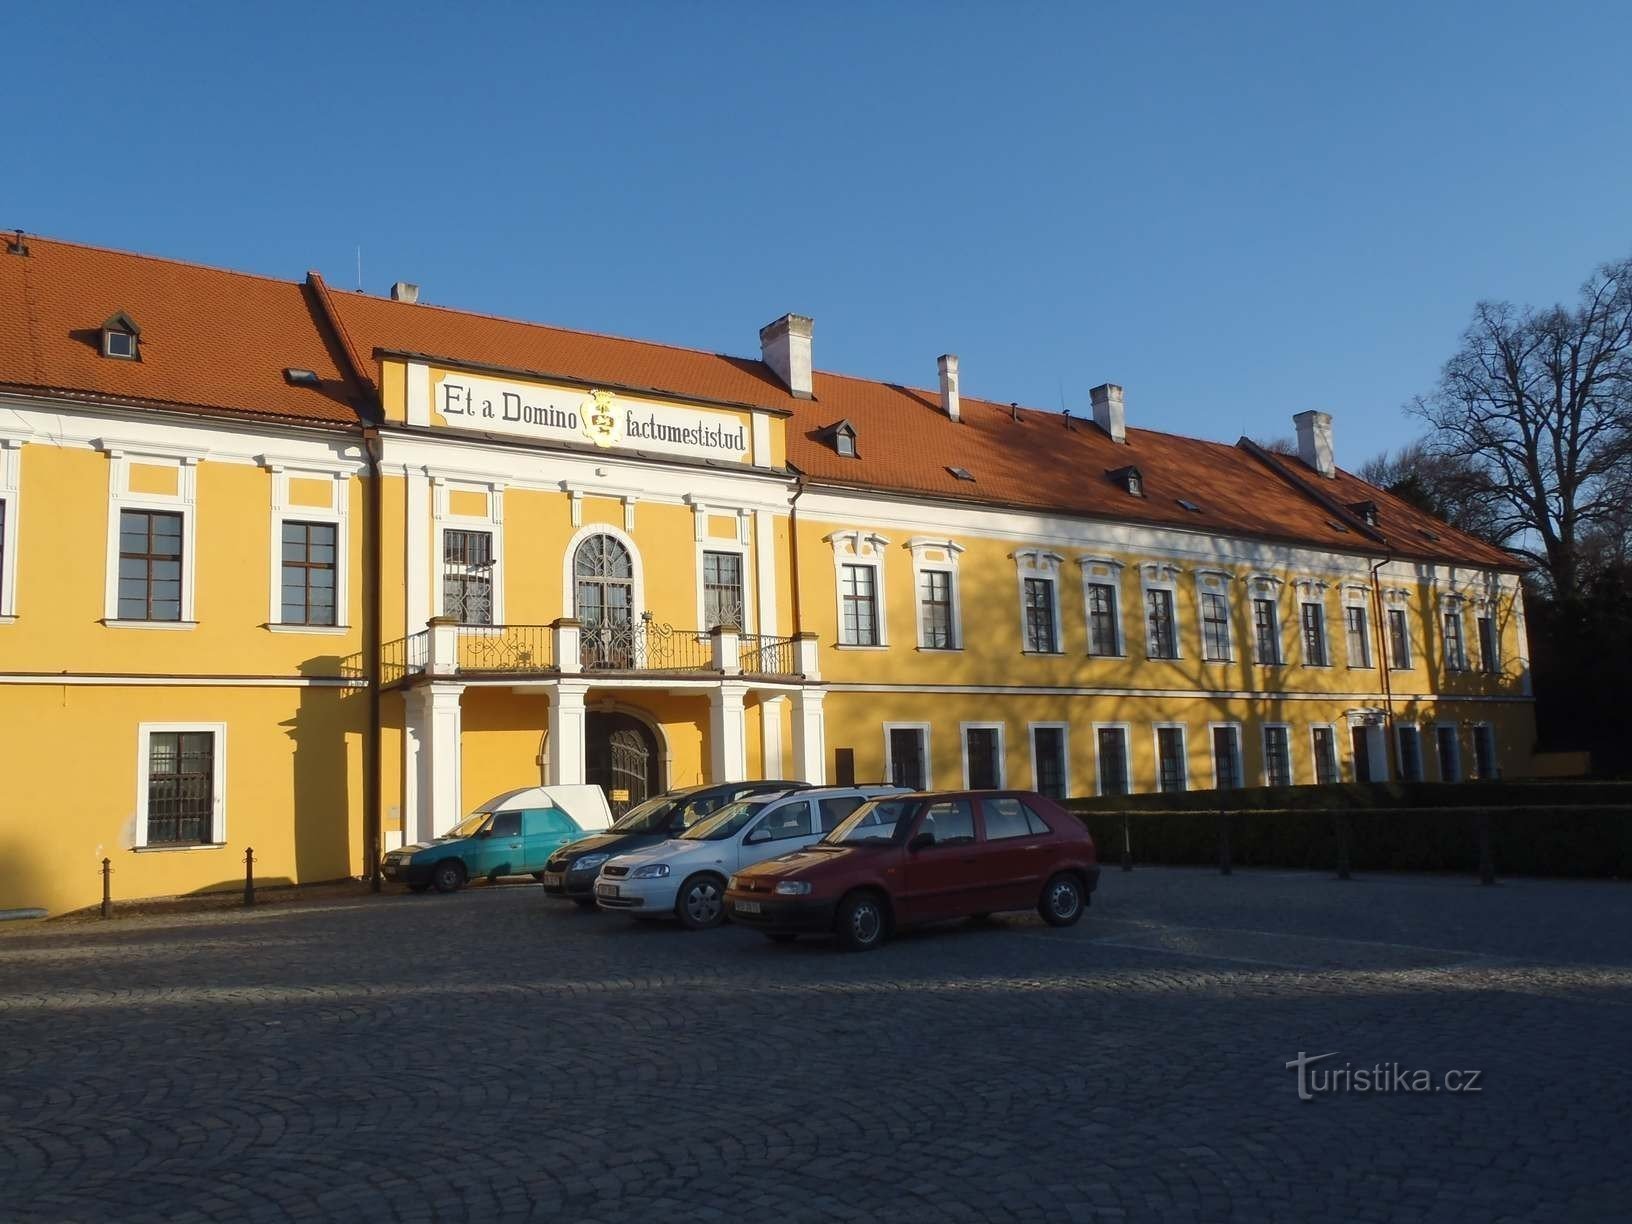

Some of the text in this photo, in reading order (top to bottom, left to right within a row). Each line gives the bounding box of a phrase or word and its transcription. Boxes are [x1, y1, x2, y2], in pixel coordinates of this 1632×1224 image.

[443, 384, 746, 450] Et a Domino factumestistud
